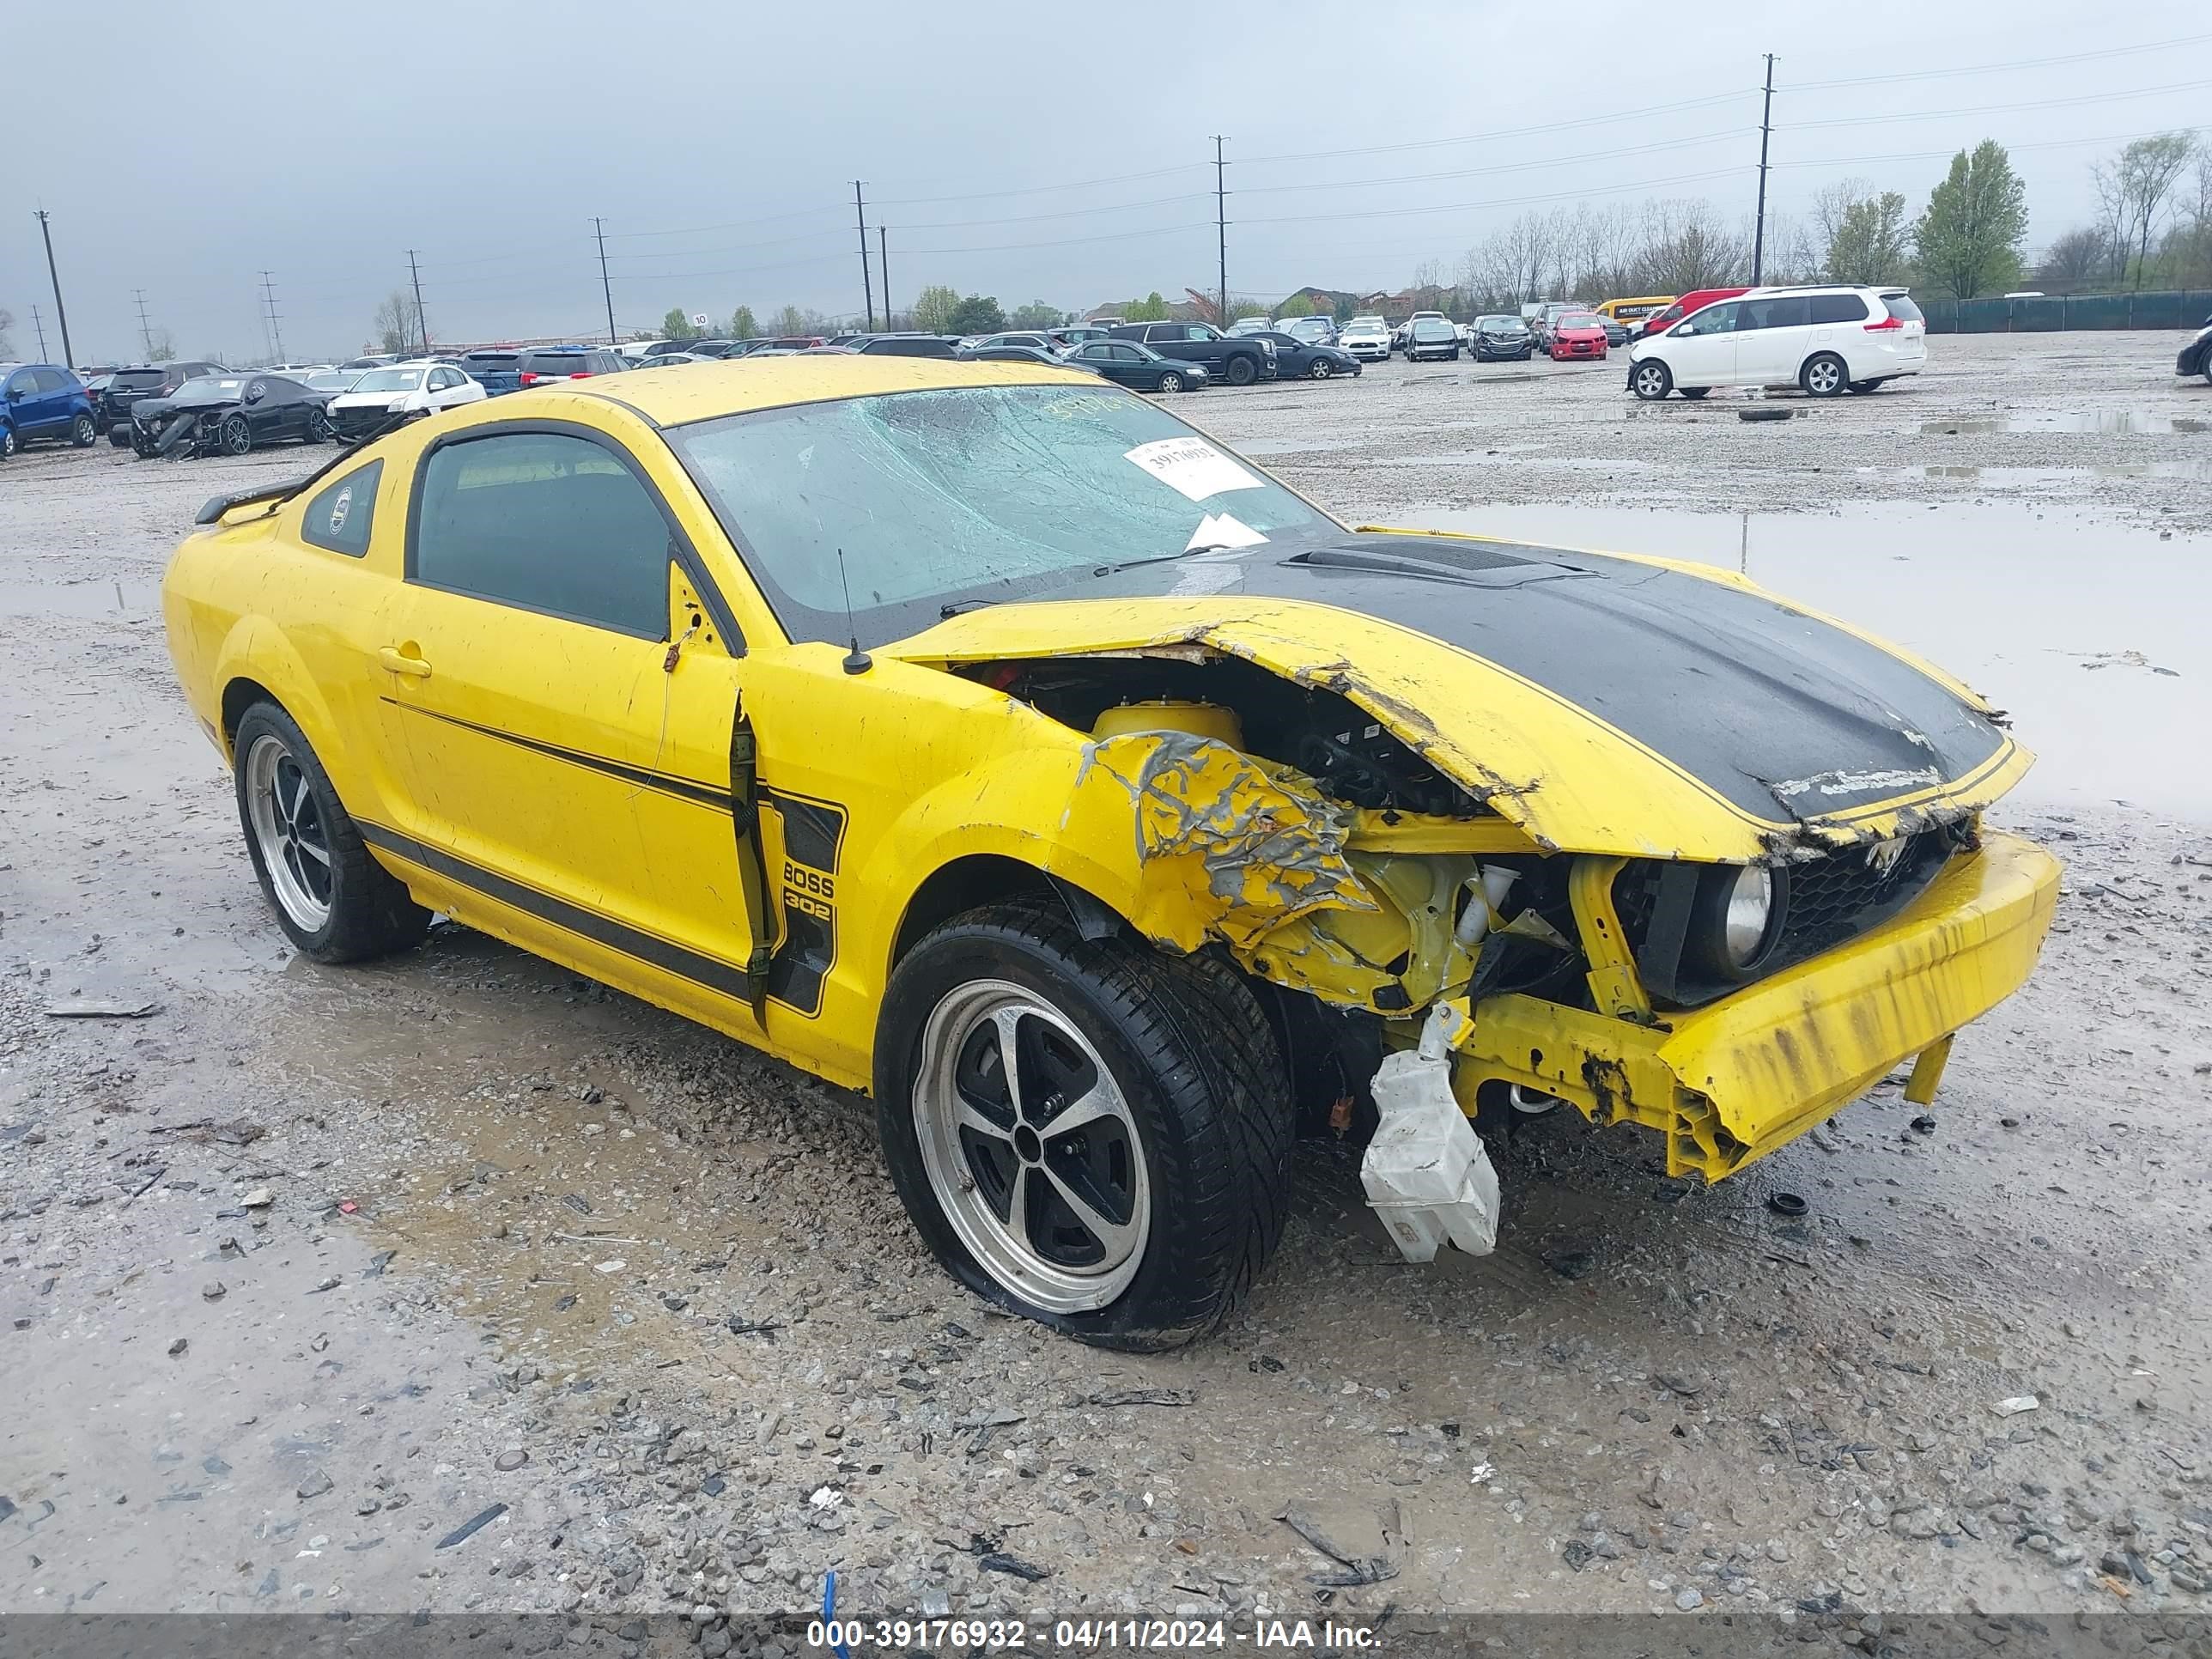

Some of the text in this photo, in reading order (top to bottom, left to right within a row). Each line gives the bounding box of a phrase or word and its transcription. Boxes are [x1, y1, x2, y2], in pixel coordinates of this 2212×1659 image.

[695, 315, 706, 325] 10
[783, 860, 835, 899] BOSS
[785, 891, 830, 921] 302
